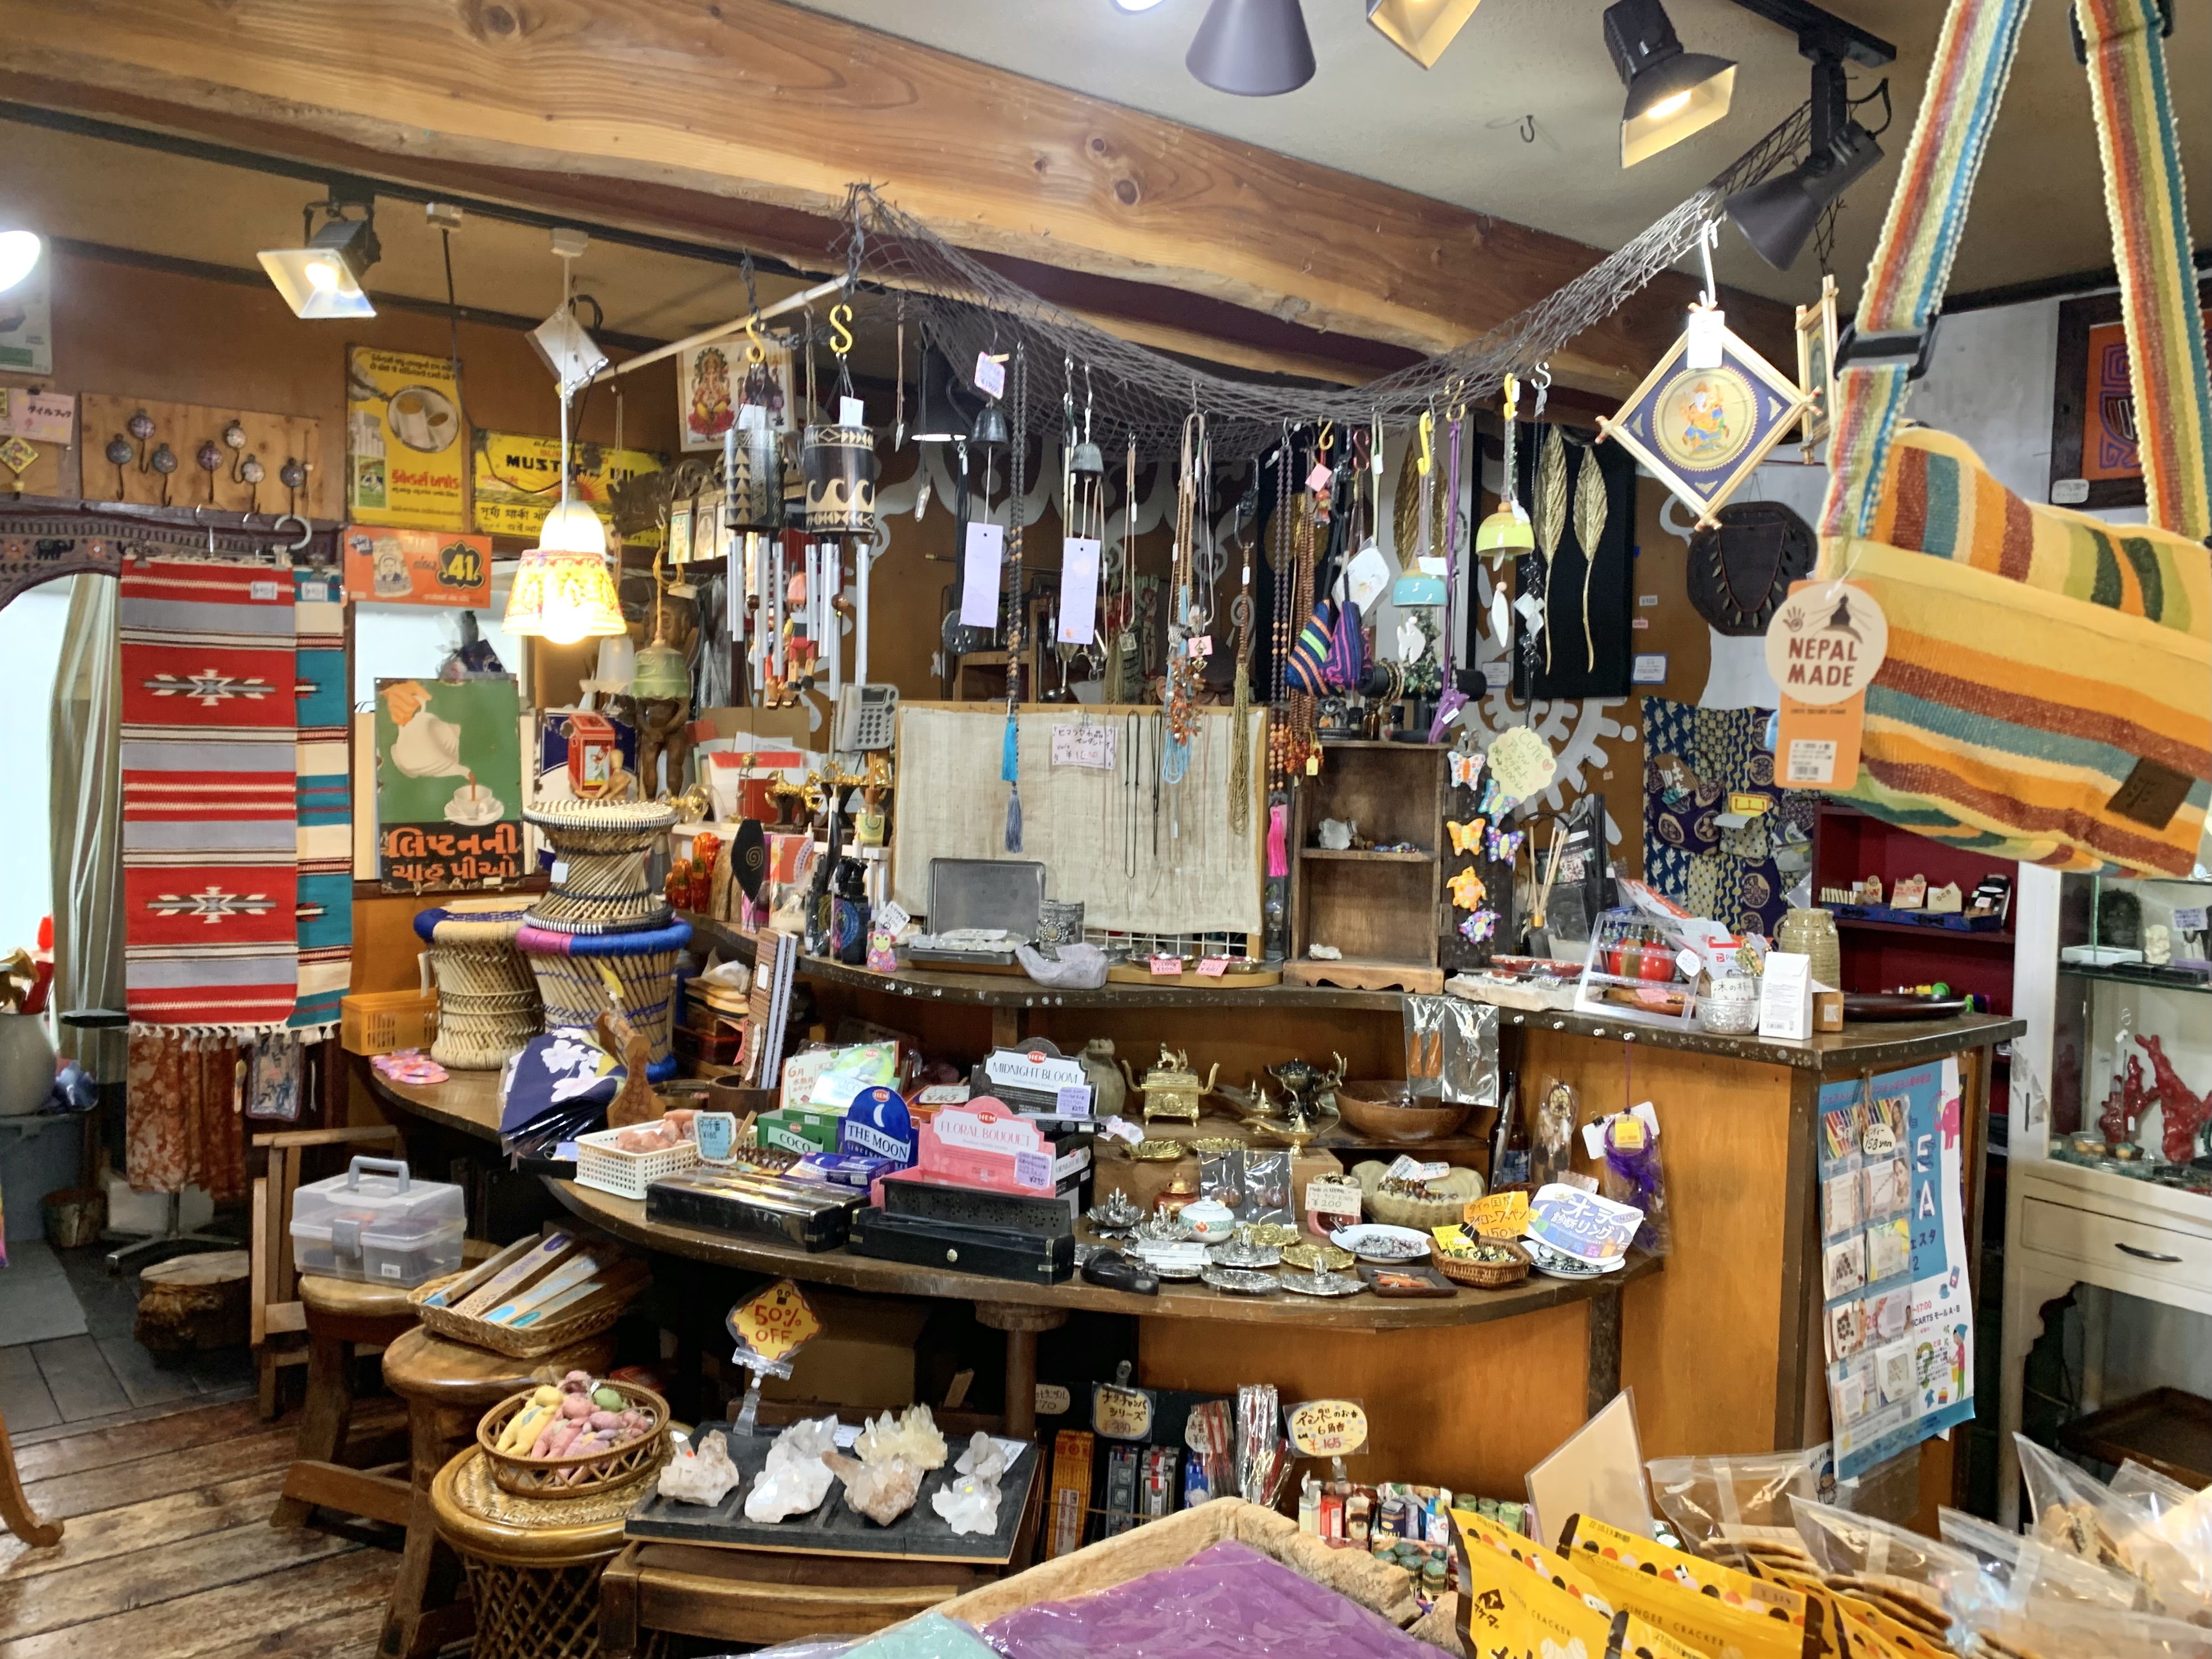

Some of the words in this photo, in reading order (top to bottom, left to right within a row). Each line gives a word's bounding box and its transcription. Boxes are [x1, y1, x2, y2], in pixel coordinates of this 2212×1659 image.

[448, 554, 476, 581] 41
[1788, 637, 1858, 662] NEPAL
[1787, 663, 1855, 687] MADE
[1518, 732, 1543, 763] CUTE
[392, 863, 444, 882] ચાહ
[1028, 1053, 1046, 1062] HEM
[992, 1062, 1040, 1079] MIDNIGHT
[1042, 1070, 1078, 1084] BLOOM
[978, 1113, 996, 1122] HEM
[780, 1133, 810, 1152] COCO
[847, 1124, 870, 1143] THE
[873, 1132, 908, 1159] MOON
[940, 1120, 979, 1137] FLORAL
[982, 1127, 1031, 1146] BOUQUET
[1865, 1138, 1879, 1151] 158
[1311, 1198, 1342, 1208] ¥200
[1562, 1197, 1614, 1223] オーラ
[1550, 1211, 1617, 1239] 診断リング
[754, 1304, 802, 1329] 50%
[755, 1328, 790, 1345] OFF
[1109, 1407, 1147, 1421] シリーズ
[1531, 1610, 1571, 1637] CRACKER
[1623, 1602, 1663, 1625] GINGER
[1673, 1622, 1725, 1647] CRACKER
